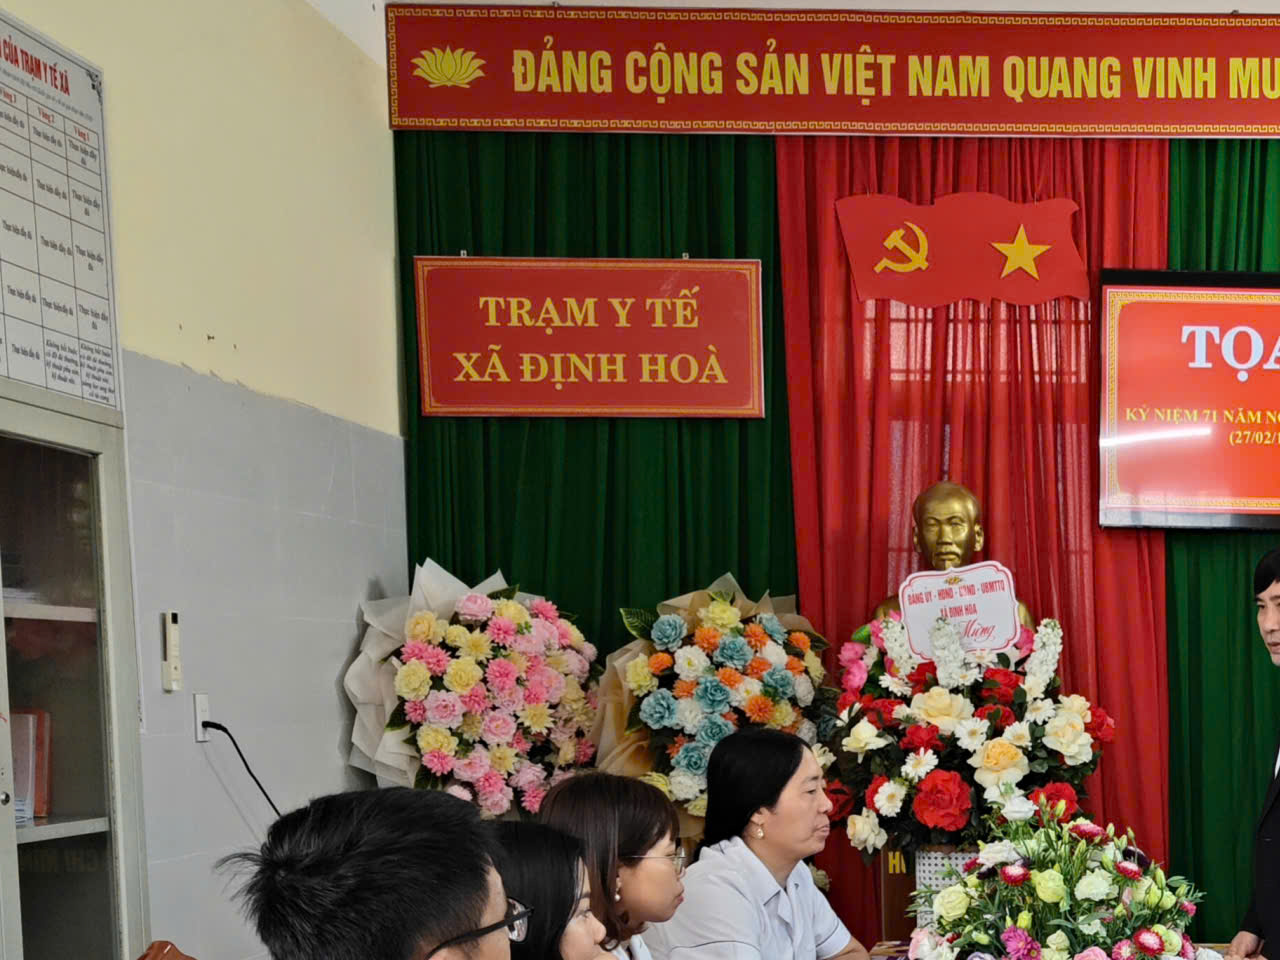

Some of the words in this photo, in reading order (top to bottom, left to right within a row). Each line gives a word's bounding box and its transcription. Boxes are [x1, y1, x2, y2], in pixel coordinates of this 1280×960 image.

[512, 36, 613, 95] ĐẢNG
[625, 42, 723, 104] CỘNG
[736, 38, 810, 97] SẢN
[821, 45, 897, 106] VIỆT
[908, 55, 990, 98] NAM
[1003, 55, 1121, 104] QUANG
[1132, 57, 1216, 99] VINH
[479, 297, 600, 336] TRẠM
[608, 297, 636, 328] Y
[646, 286, 701, 328] TẾ
[453, 346, 511, 382] XÃ
[520, 354, 627, 390] ĐỊNH
[639, 345, 728, 384] HOÀ
[1154, 407, 1198, 425] NIỆM
[1203, 409, 1218, 423] 71
[1223, 407, 1262, 424] NĂM
